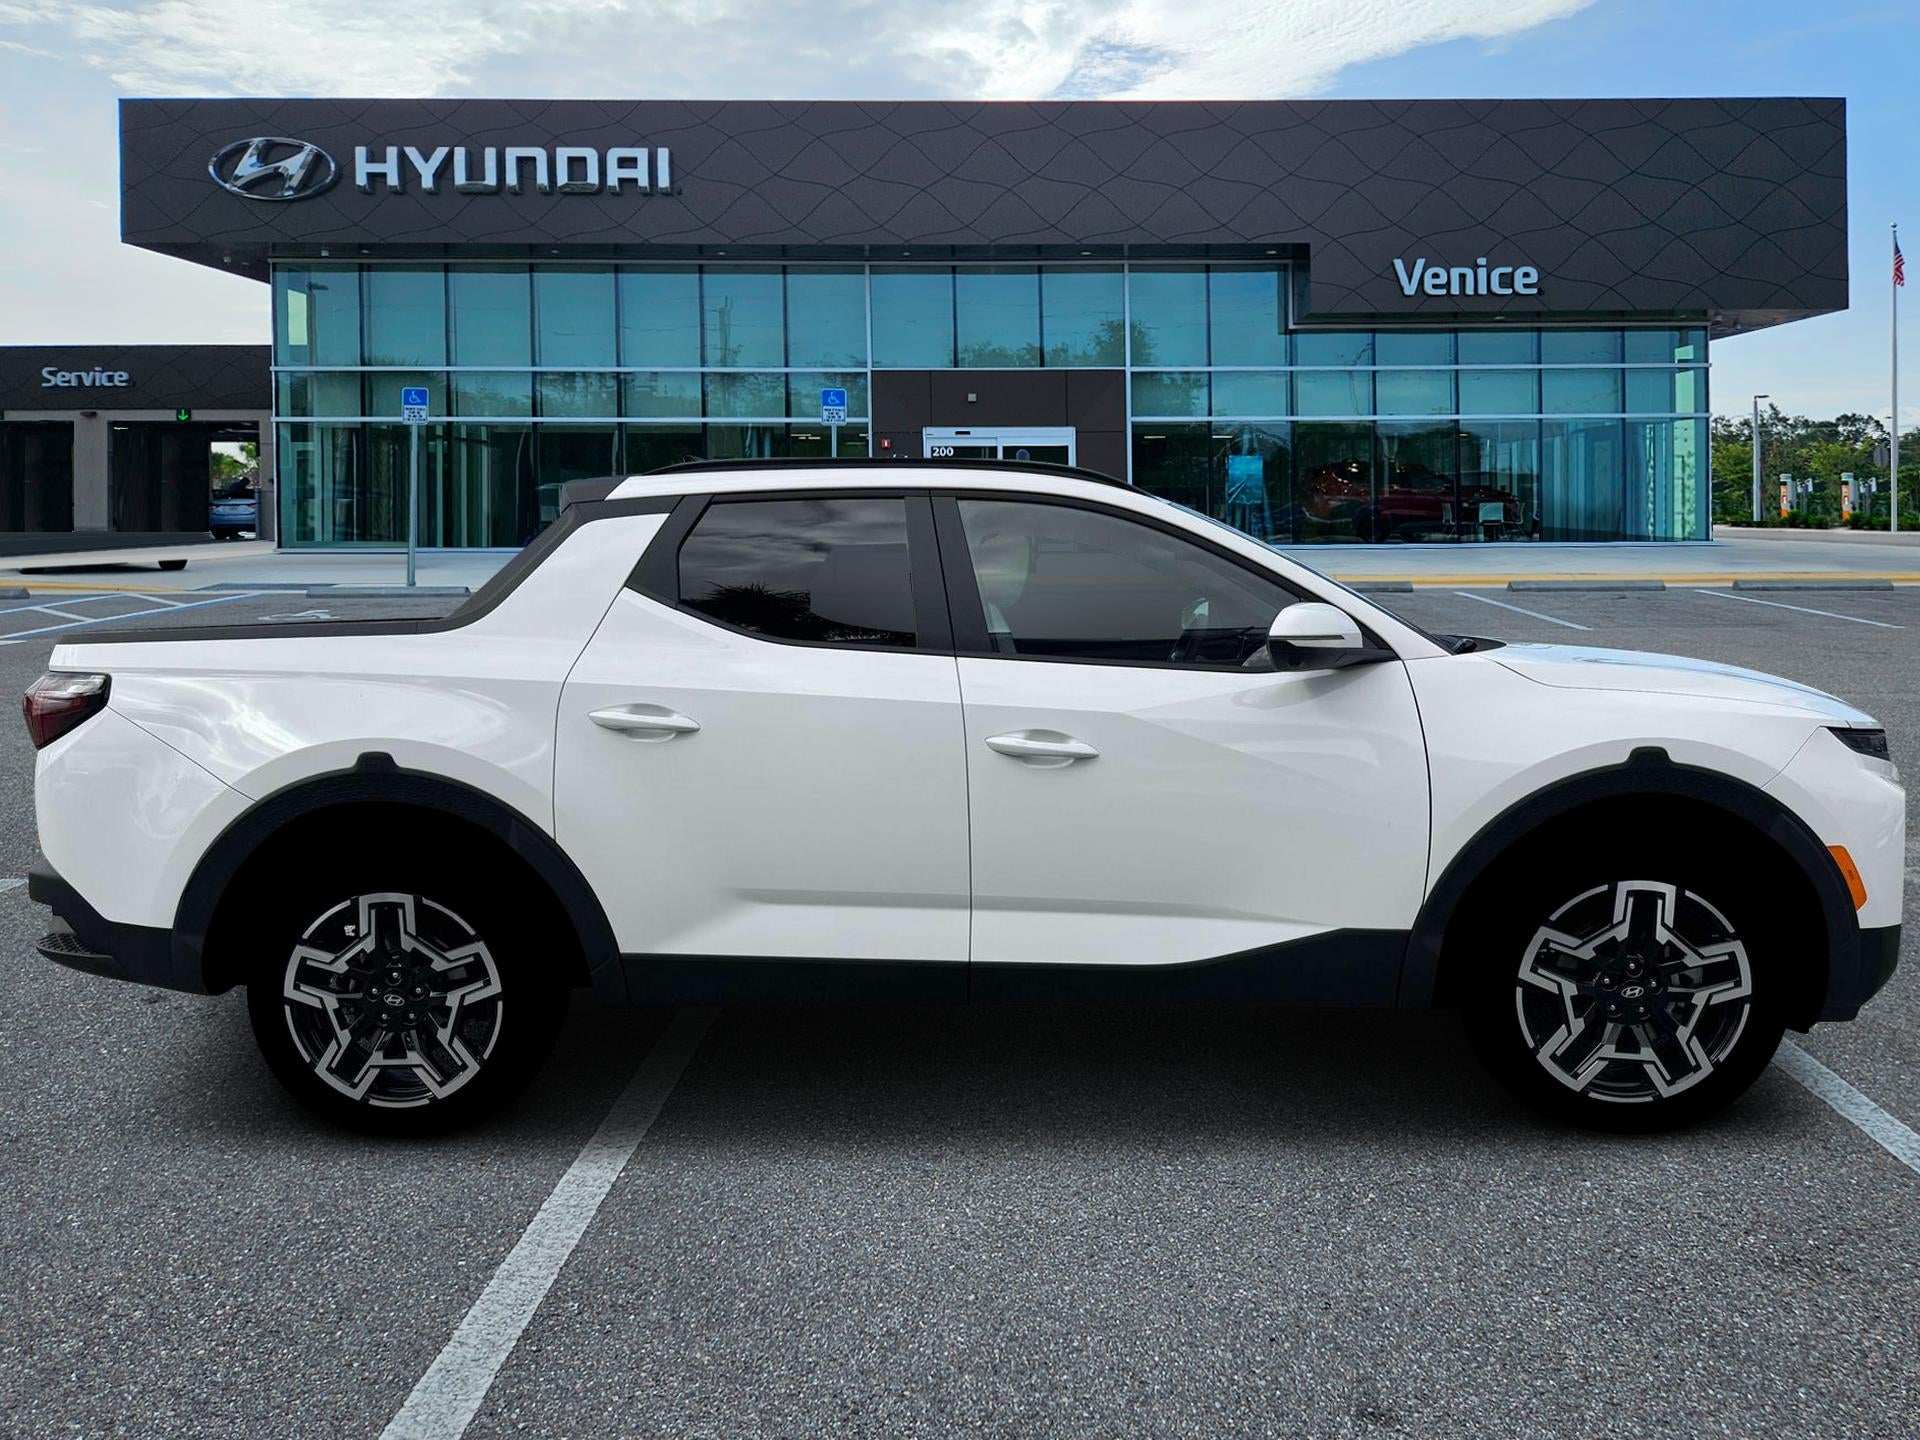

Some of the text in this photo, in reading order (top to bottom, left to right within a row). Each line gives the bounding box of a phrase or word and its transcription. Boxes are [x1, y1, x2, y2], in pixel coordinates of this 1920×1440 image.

[354, 146, 672, 195] HYUNDAI
[1392, 256, 1539, 296] Venice
[41, 366, 129, 387] Service
[932, 446, 954, 457] 200
